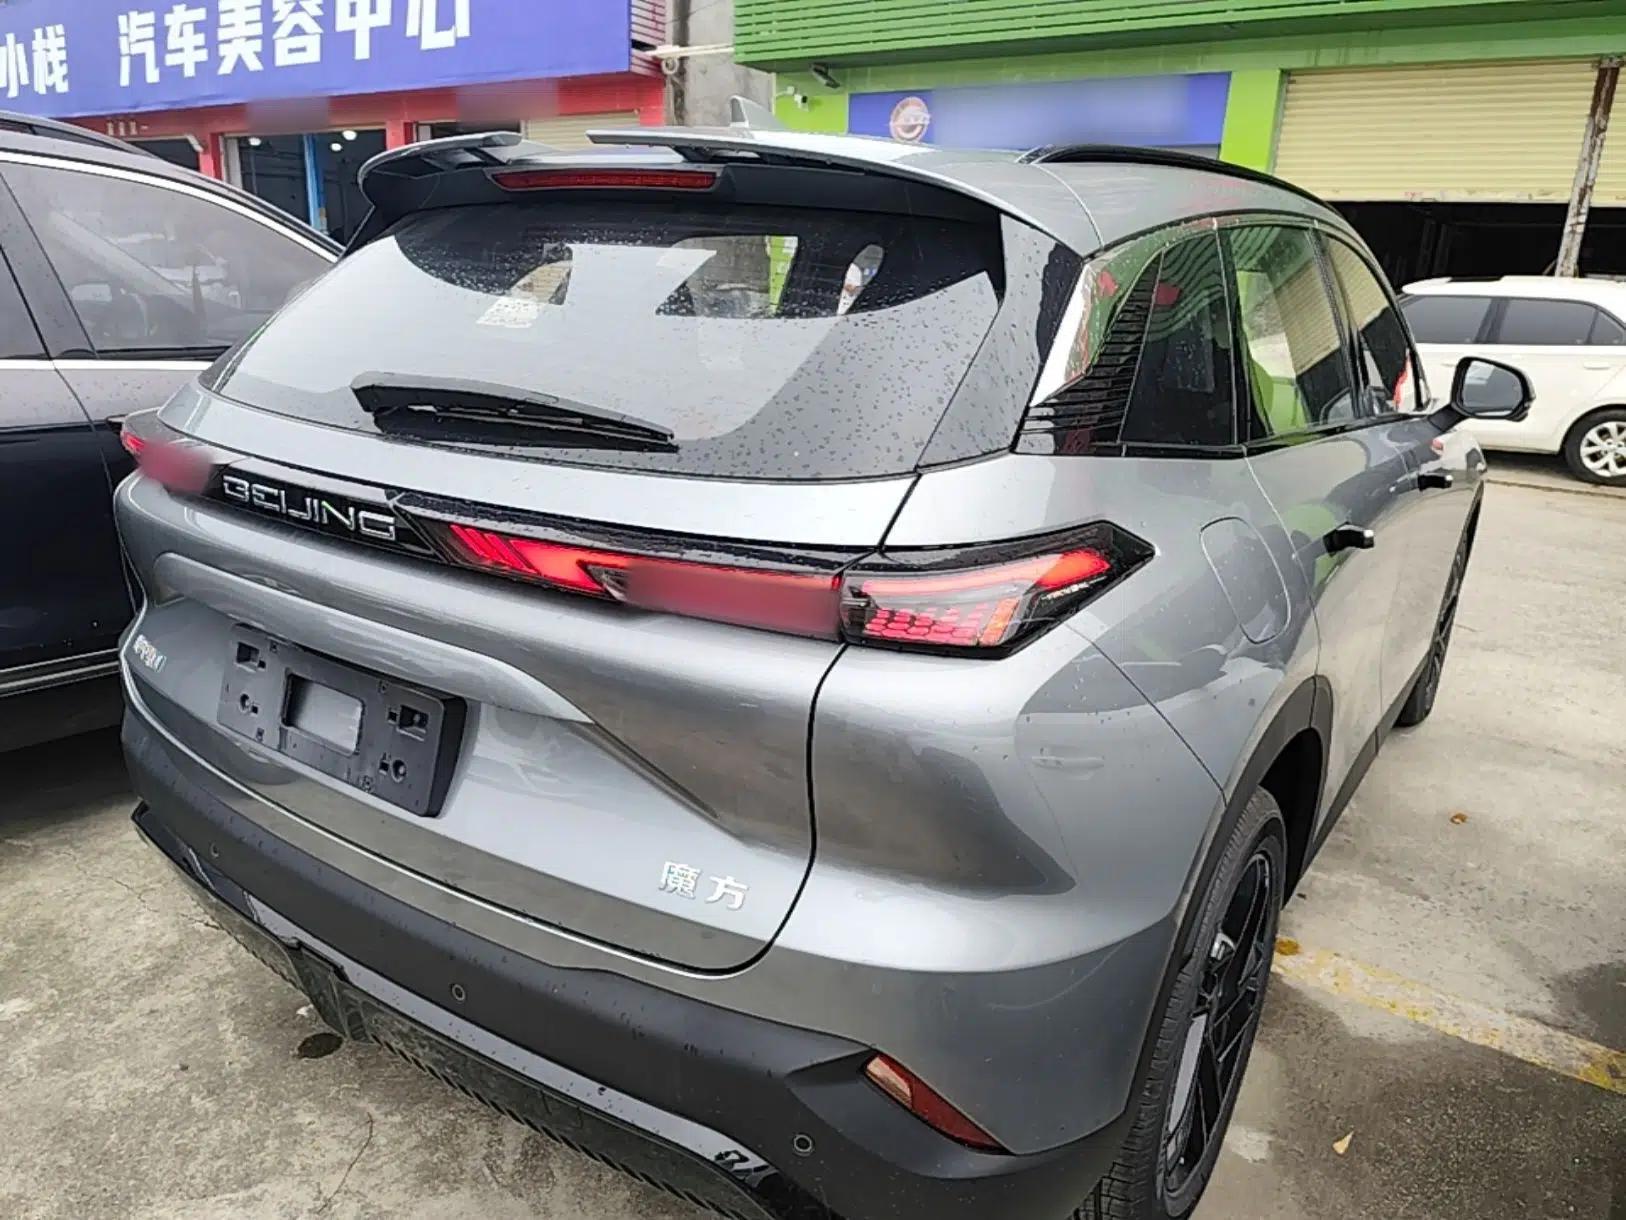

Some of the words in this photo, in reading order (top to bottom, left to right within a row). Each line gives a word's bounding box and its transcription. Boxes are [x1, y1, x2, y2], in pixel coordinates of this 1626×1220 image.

[0, 24, 69, 98] 小栈
[118, 0, 470, 87] 汽车美容中心
[222, 475, 396, 541] BEIJING
[659, 860, 750, 911] 魔方
